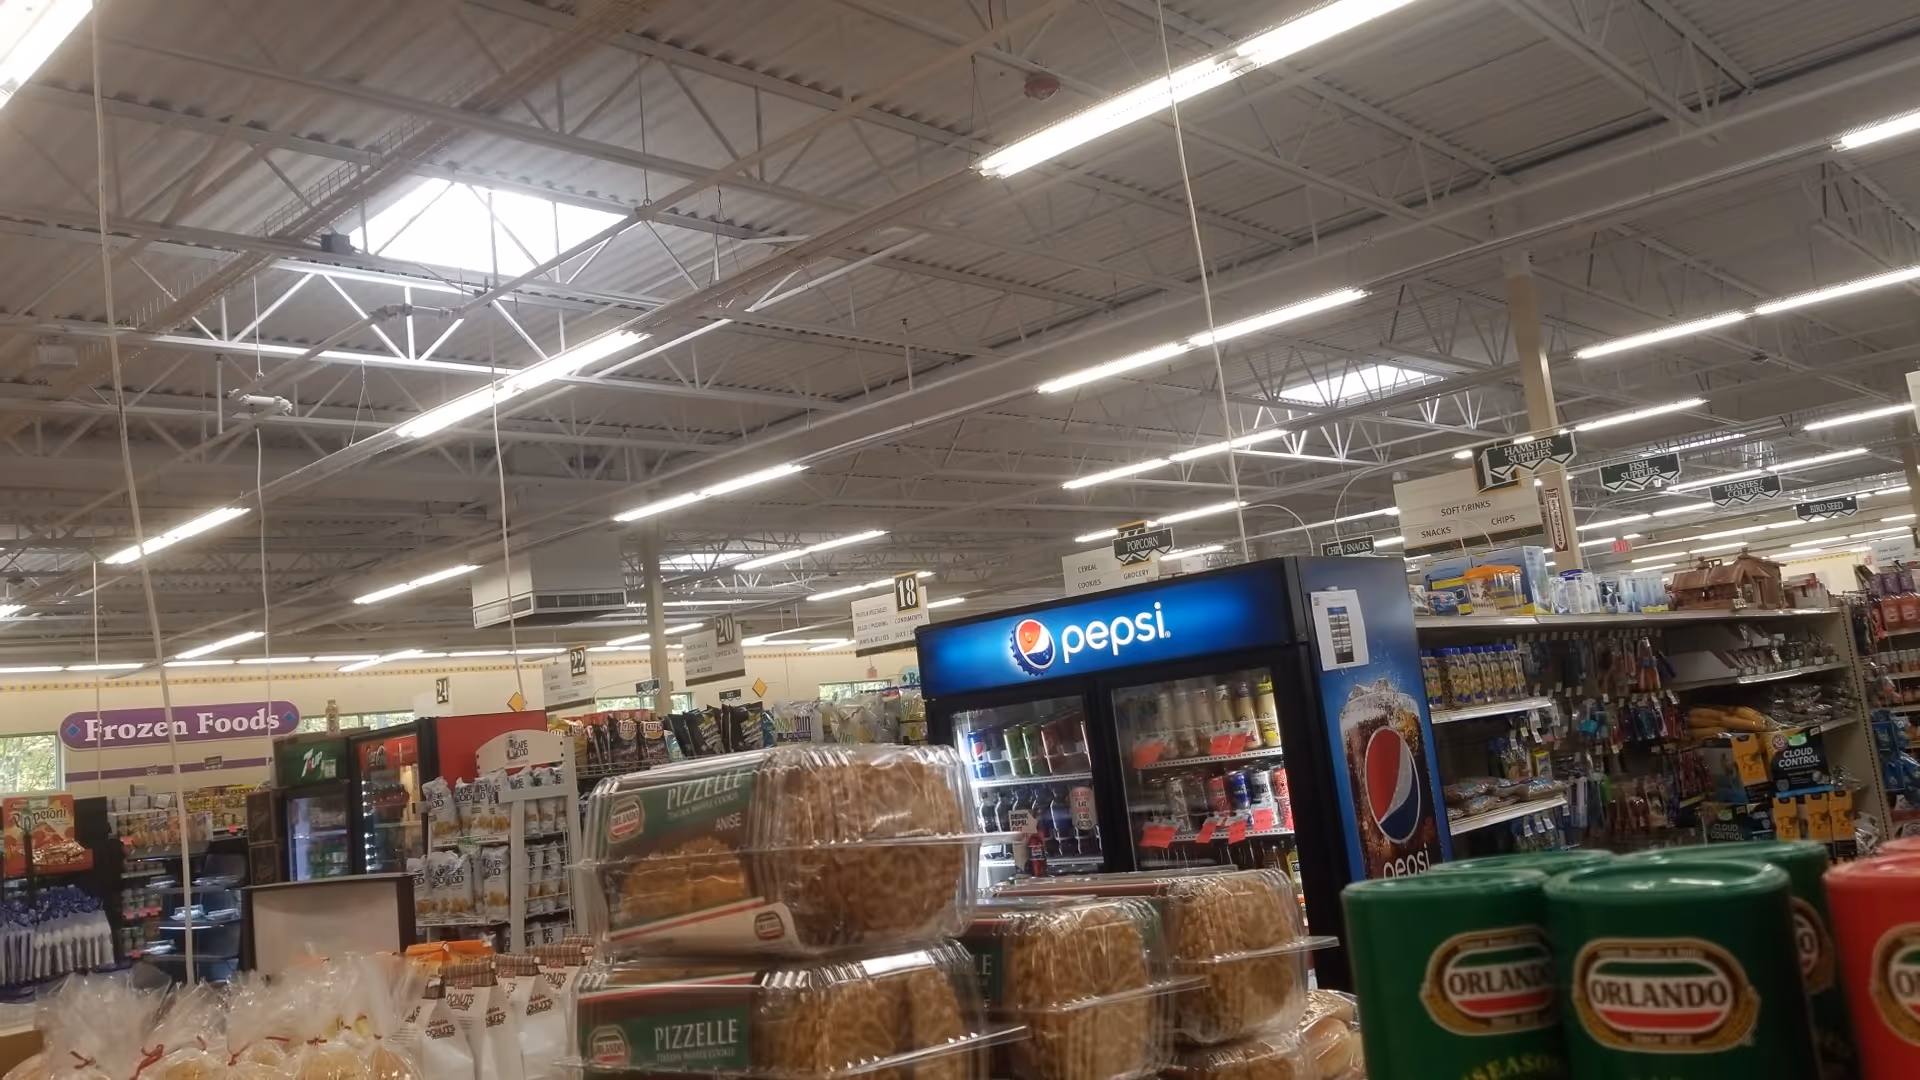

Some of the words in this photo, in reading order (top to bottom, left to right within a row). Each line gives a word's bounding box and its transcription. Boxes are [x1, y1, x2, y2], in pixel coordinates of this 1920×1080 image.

[1504, 438, 1554, 457] HAMSTER
[1508, 448, 1552, 465] SUPPLIES
[1620, 467, 1661, 481] SUPPLIES
[1629, 461, 1649, 473] FISH
[1724, 480, 1759, 493] LEASHES
[1727, 485, 1765, 498] COLLARS
[1441, 505, 1460, 517] SOFT
[1461, 501, 1491, 513] DRINKS
[1809, 502, 1826, 514] BIRD
[1827, 501, 1844, 511] SEED
[1491, 514, 1516, 526] CHIPS
[1421, 526, 1452, 539] SNACKS
[1127, 536, 1159, 552] POPCORN
[1078, 563, 1098, 574] CEREAL
[1123, 568, 1150, 580] GROCERY
[1077, 579, 1102, 590] COOKIES
[897, 577, 917, 608] 18
[717, 616, 733, 643] 20
[1061, 601, 1165, 664] pepsi
[572, 649, 585, 674] 22
[436, 679, 449, 701] 24
[84, 718, 188, 742] Frozen
[197, 707, 280, 735] Foods
[1783, 747, 1814, 759] CLOUD
[1778, 754, 1821, 768] CONTROL
[667, 768, 741, 810] PIZZELLE
[715, 812, 742, 833] ANISE
[1713, 823, 1739, 832] CLOUD
[1710, 832, 1745, 841] CONTROL
[446, 993, 475, 1006] DONUTS
[1590, 978, 1729, 1009] ORLANDO
[655, 1018, 738, 1051] PIZZELLE
